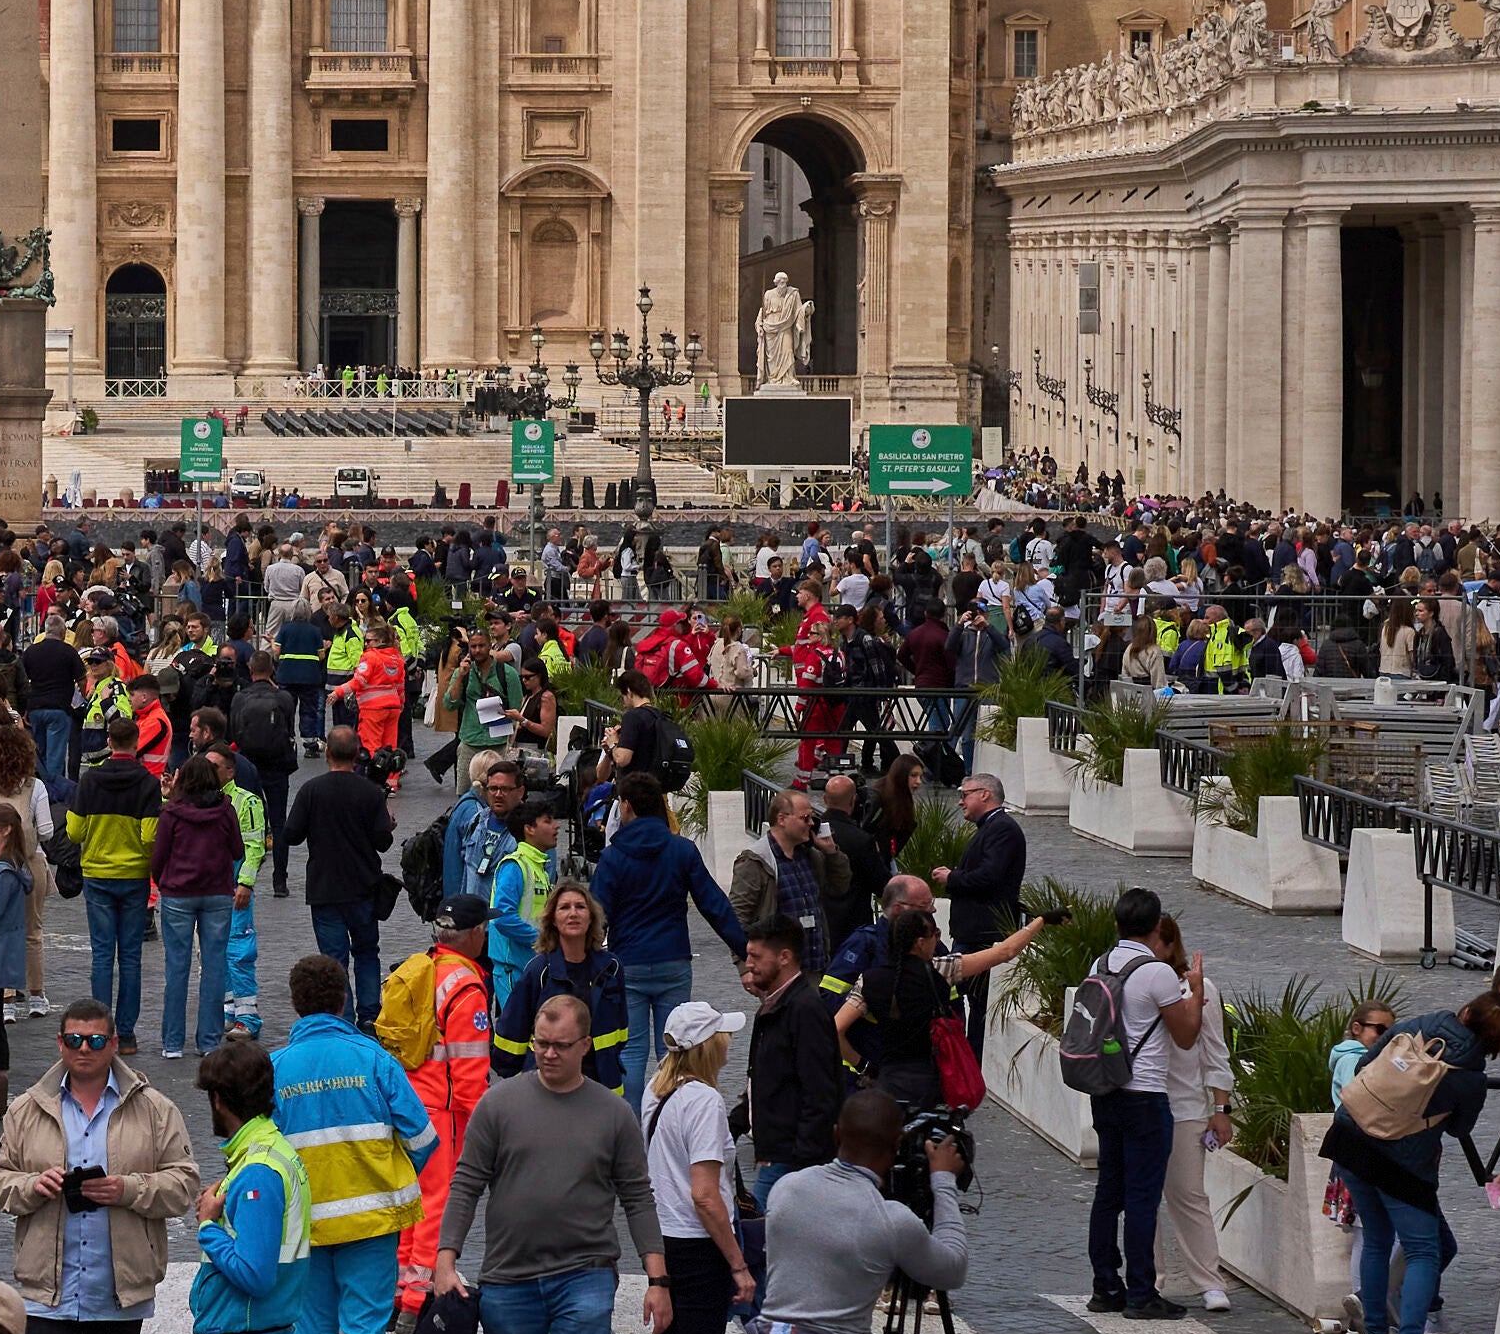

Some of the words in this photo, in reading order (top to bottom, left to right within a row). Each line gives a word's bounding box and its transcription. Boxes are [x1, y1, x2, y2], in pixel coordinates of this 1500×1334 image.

[878, 453, 912, 461] BASILICA
[913, 453, 921, 461] DI
[922, 453, 937, 461] SAN
[881, 465, 892, 473] ST.
[894, 465, 926, 473] PETER'S
[926, 465, 961, 473] BASILICA
